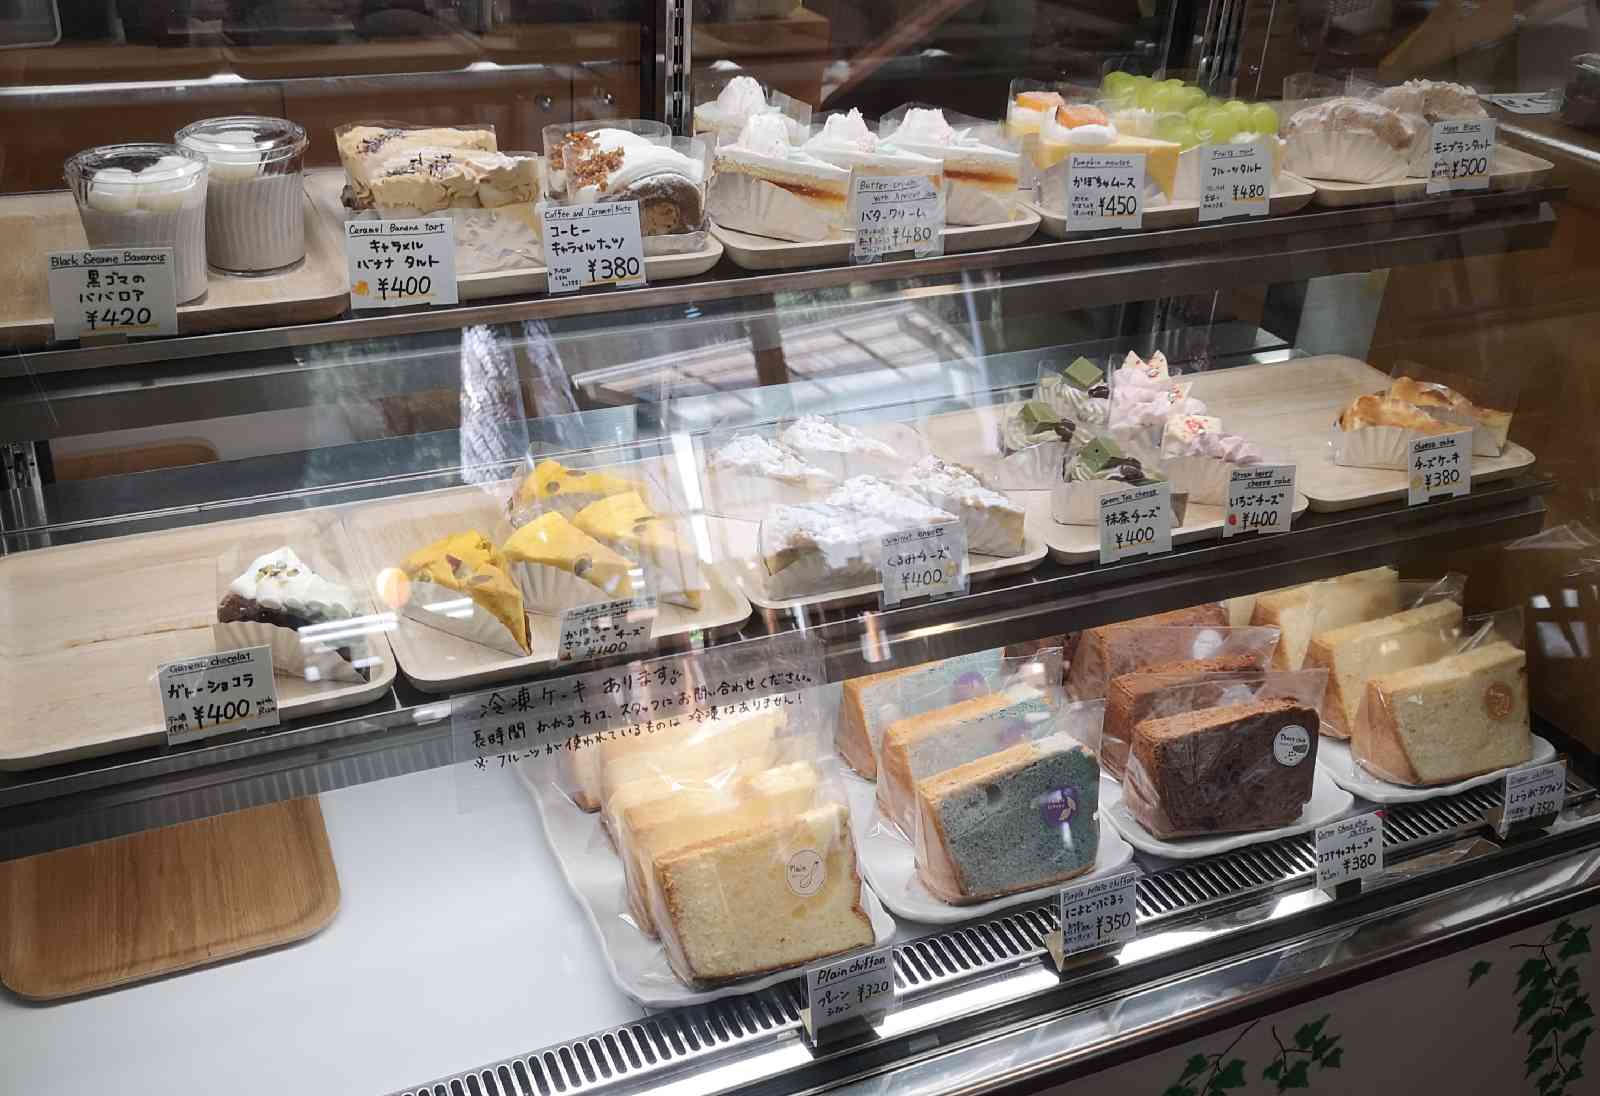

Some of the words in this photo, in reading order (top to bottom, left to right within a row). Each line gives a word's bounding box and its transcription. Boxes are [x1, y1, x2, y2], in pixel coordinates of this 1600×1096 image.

[1451, 157, 1488, 179] ¥500
[1073, 175, 1136, 188] かぼちゃムース
[1232, 184, 1265, 201] ¥480
[1098, 195, 1137, 217] ¥450
[550, 223, 591, 238] コーヒー
[891, 226, 932, 246] ¥480
[369, 239, 424, 254] キャラメル
[551, 236, 625, 257] キャラメルナッツ
[51, 254, 79, 268] Black
[356, 255, 395, 270] バナナ
[404, 254, 441, 270] タルト
[588, 256, 640, 282] ¥380
[86, 269, 146, 289] 黒ゴマの
[377, 275, 431, 301] ¥400
[79, 289, 145, 304] ババロア
[85, 306, 152, 331] ¥420
[1413, 452, 1461, 471] チーズケーキ
[1424, 469, 1460, 492] ¥380
[1105, 504, 1161, 527] 抹茶チーズ
[1242, 510, 1278, 530] ¥400
[1115, 526, 1155, 549] ¥400
[901, 568, 943, 591] ¥400
[168, 673, 255, 699] ガトーショコラ
[480, 678, 587, 718] 冷凍ケーキ
[192, 698, 250, 730] ¥400
[472, 721, 526, 749] 長時間
[1343, 853, 1377, 875] ¥380
[1096, 911, 1131, 940] ¥350
[817, 967, 848, 984] Plain
[849, 955, 886, 973] chiffon
[857, 981, 889, 1003] ¥320
